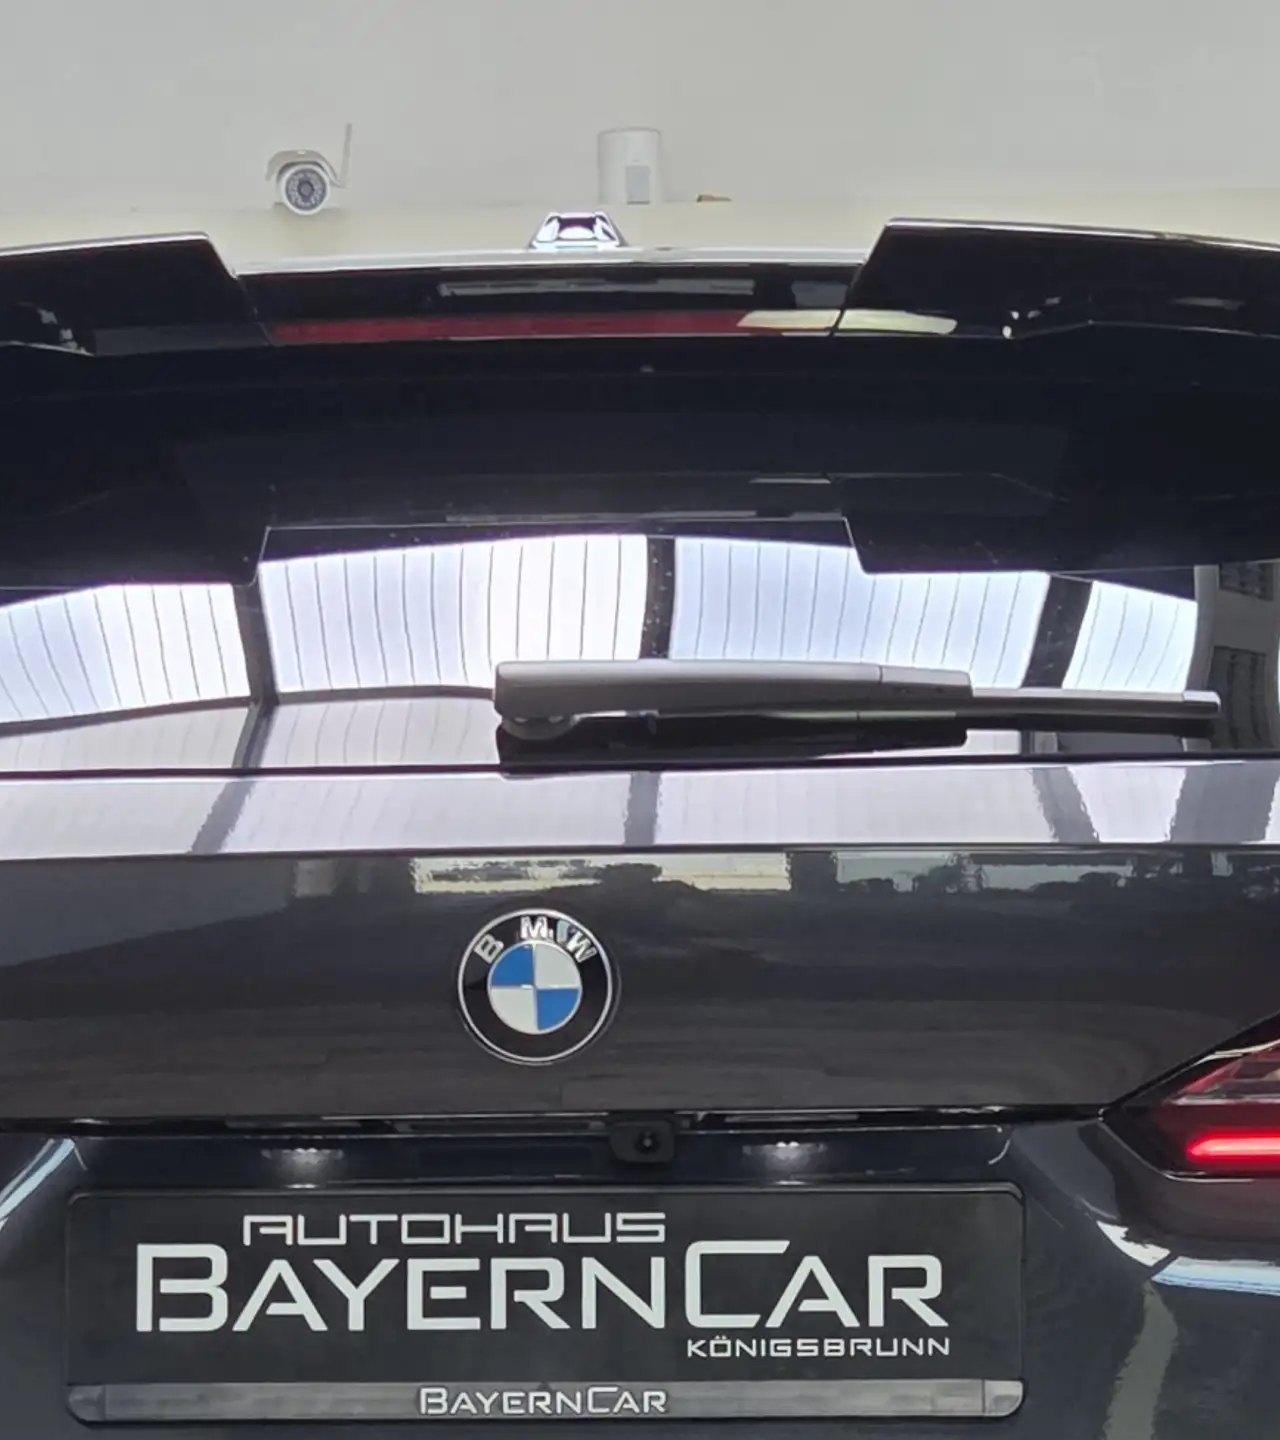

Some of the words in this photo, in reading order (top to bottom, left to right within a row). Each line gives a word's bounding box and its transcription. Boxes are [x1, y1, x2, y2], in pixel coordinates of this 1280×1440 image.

[473, 915, 598, 964] BMW
[243, 1212, 666, 1246] AUTOHAUS
[687, 1334, 950, 1358] KÖNIGSBRUNN
